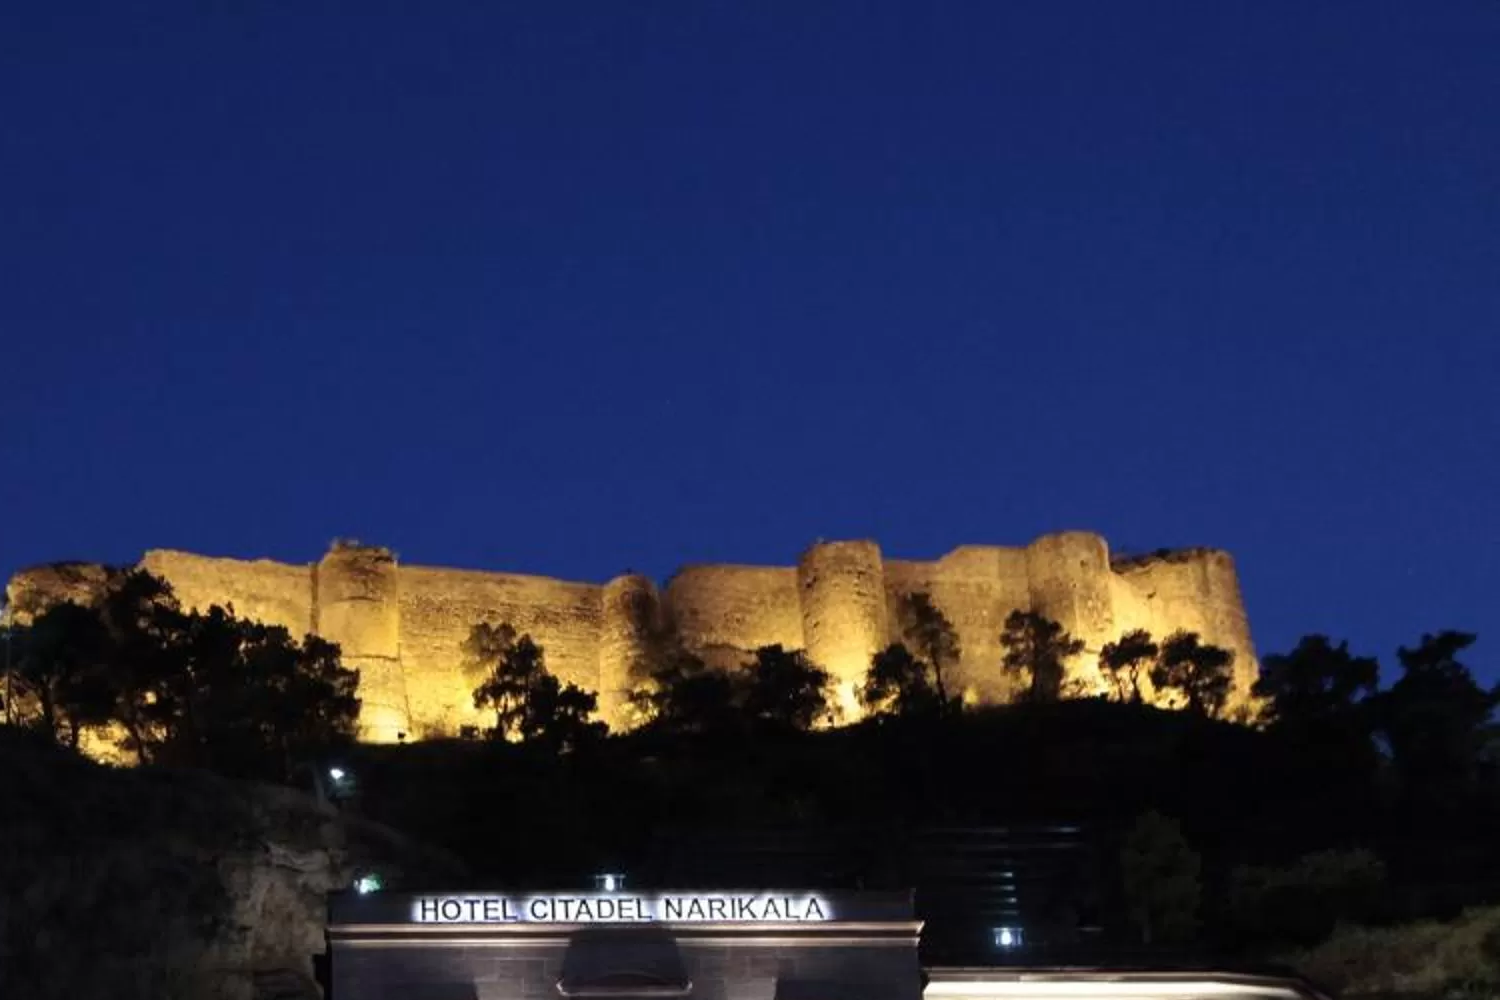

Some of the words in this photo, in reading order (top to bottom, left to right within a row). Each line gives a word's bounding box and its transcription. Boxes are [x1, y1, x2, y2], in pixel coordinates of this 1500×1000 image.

[420, 897, 518, 921] HOTEL
[530, 897, 653, 921] CITADEL
[663, 896, 825, 920] NARIKALA
